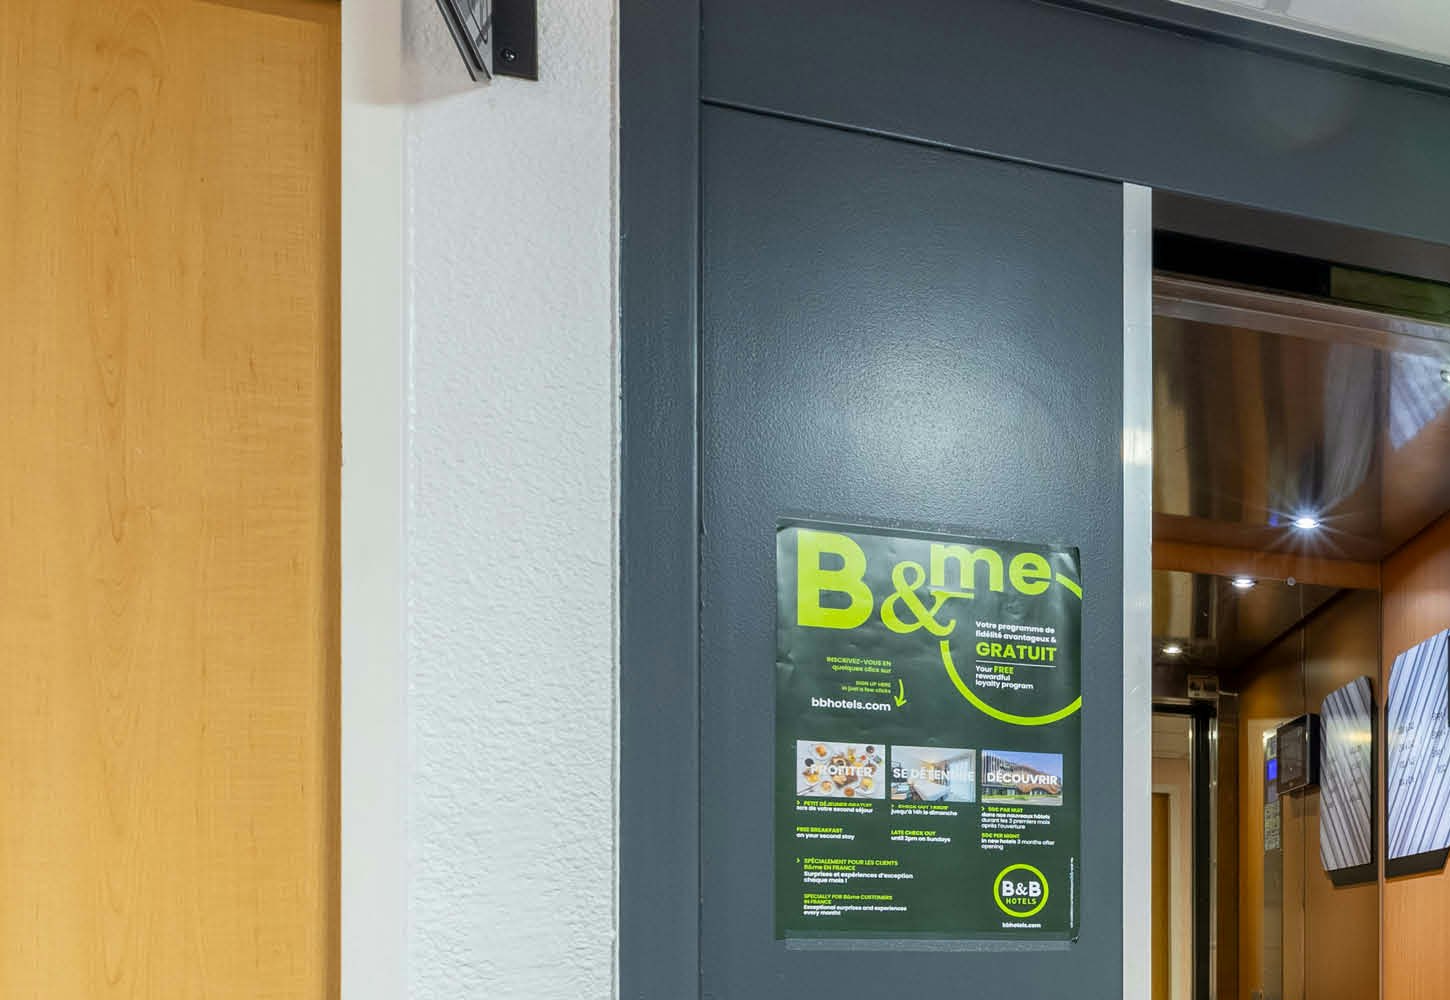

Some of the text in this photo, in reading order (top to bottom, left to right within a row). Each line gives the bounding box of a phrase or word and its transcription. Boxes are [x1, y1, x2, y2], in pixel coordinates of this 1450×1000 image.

[976, 621, 997, 629] Votre
[998, 624, 1044, 633] programme
[976, 630, 1002, 639] fidélité
[1004, 634, 1050, 643] avantageux
[976, 642, 1057, 662] GRATUIT
[994, 666, 1014, 675] FREE
[976, 680, 1034, 690] loyalty program
[811, 697, 891, 711] bbhotels.com
[893, 766, 975, 782] SE DÉTENE
[987, 769, 1058, 785] DÉCOUVRIR
[1002, 881, 1041, 897] B&B
